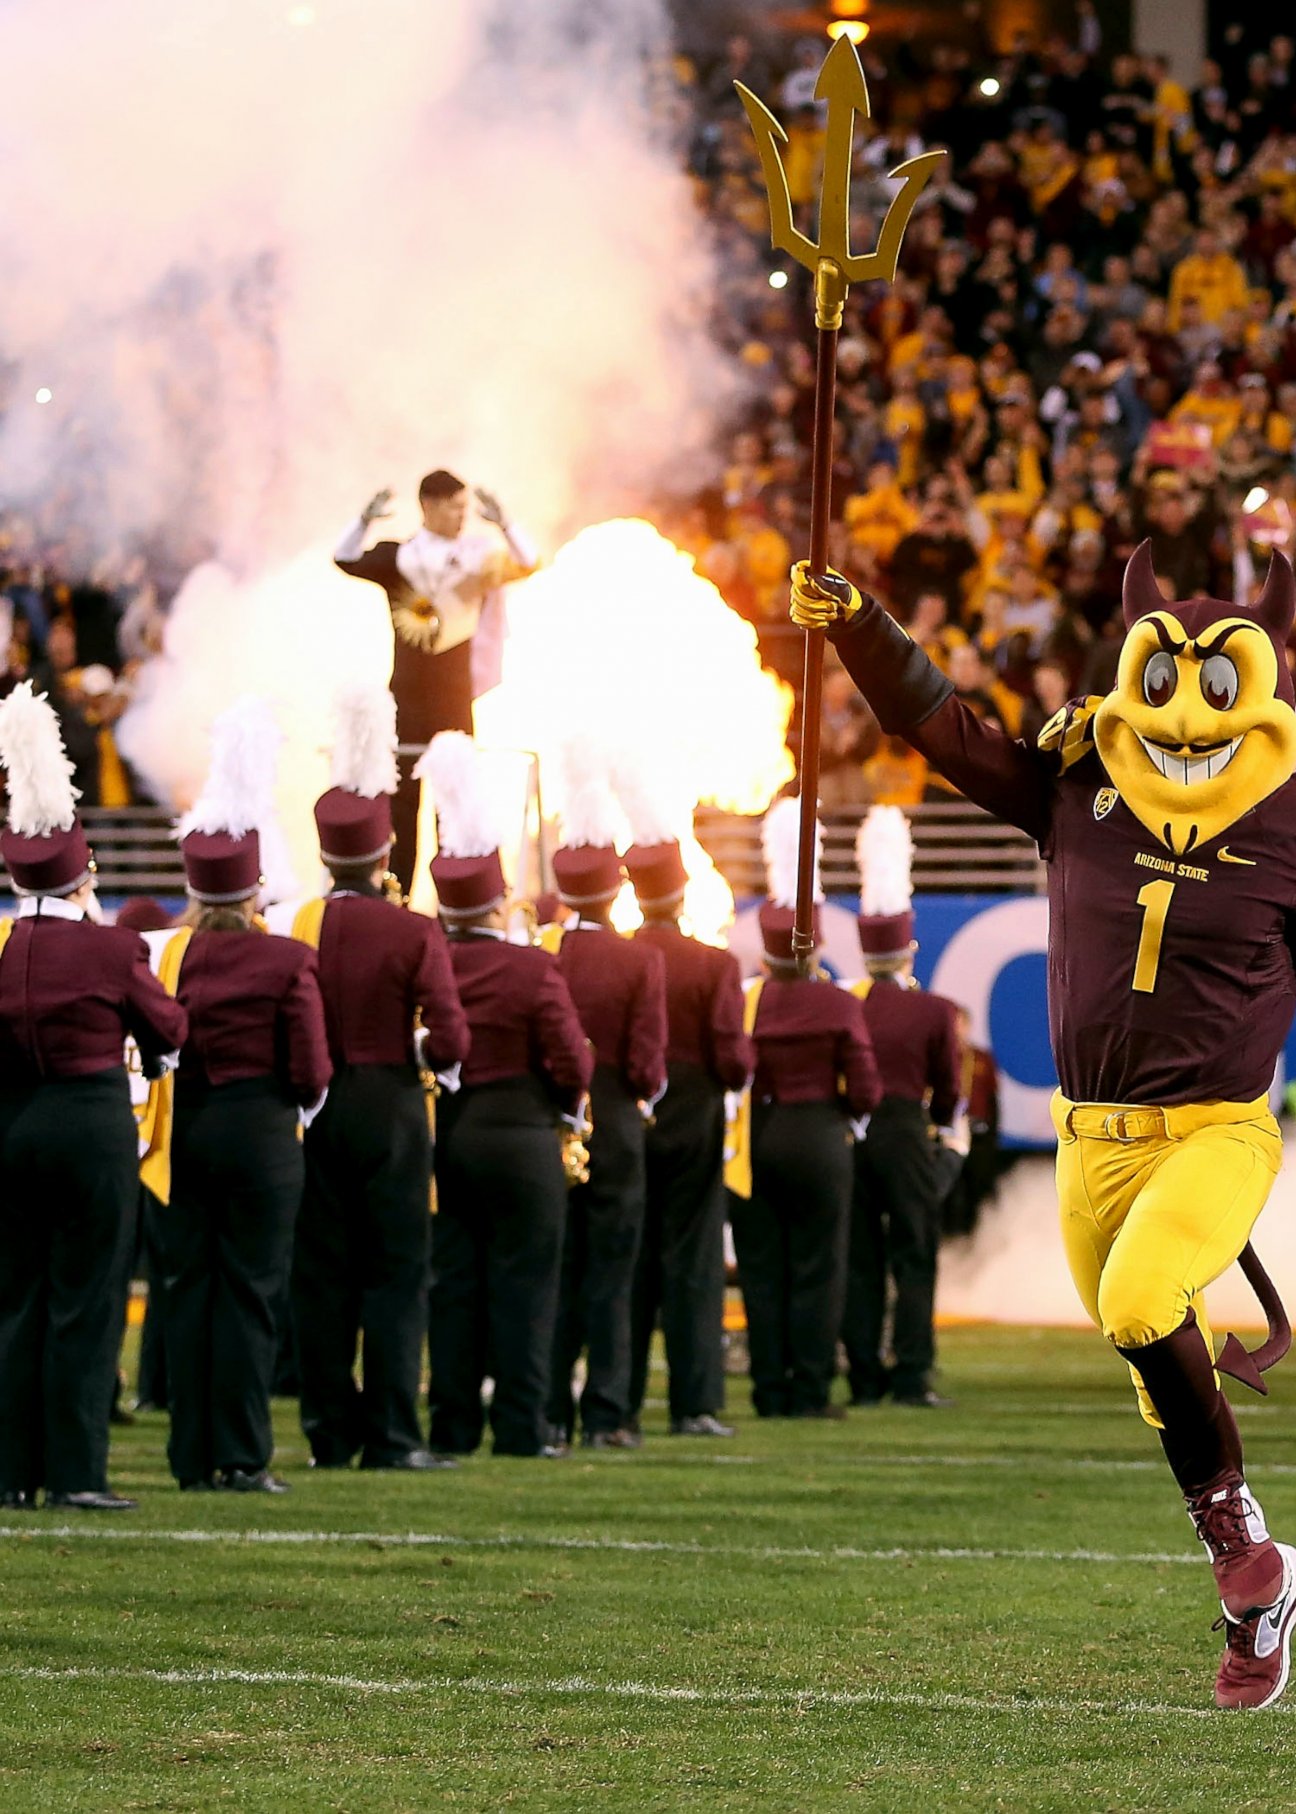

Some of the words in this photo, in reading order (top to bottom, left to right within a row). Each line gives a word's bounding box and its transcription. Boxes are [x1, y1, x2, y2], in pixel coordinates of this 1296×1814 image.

[1134, 852, 1175, 874] ARIZONA
[1176, 863, 1209, 882] STATE
[1132, 878, 1176, 993] 1
